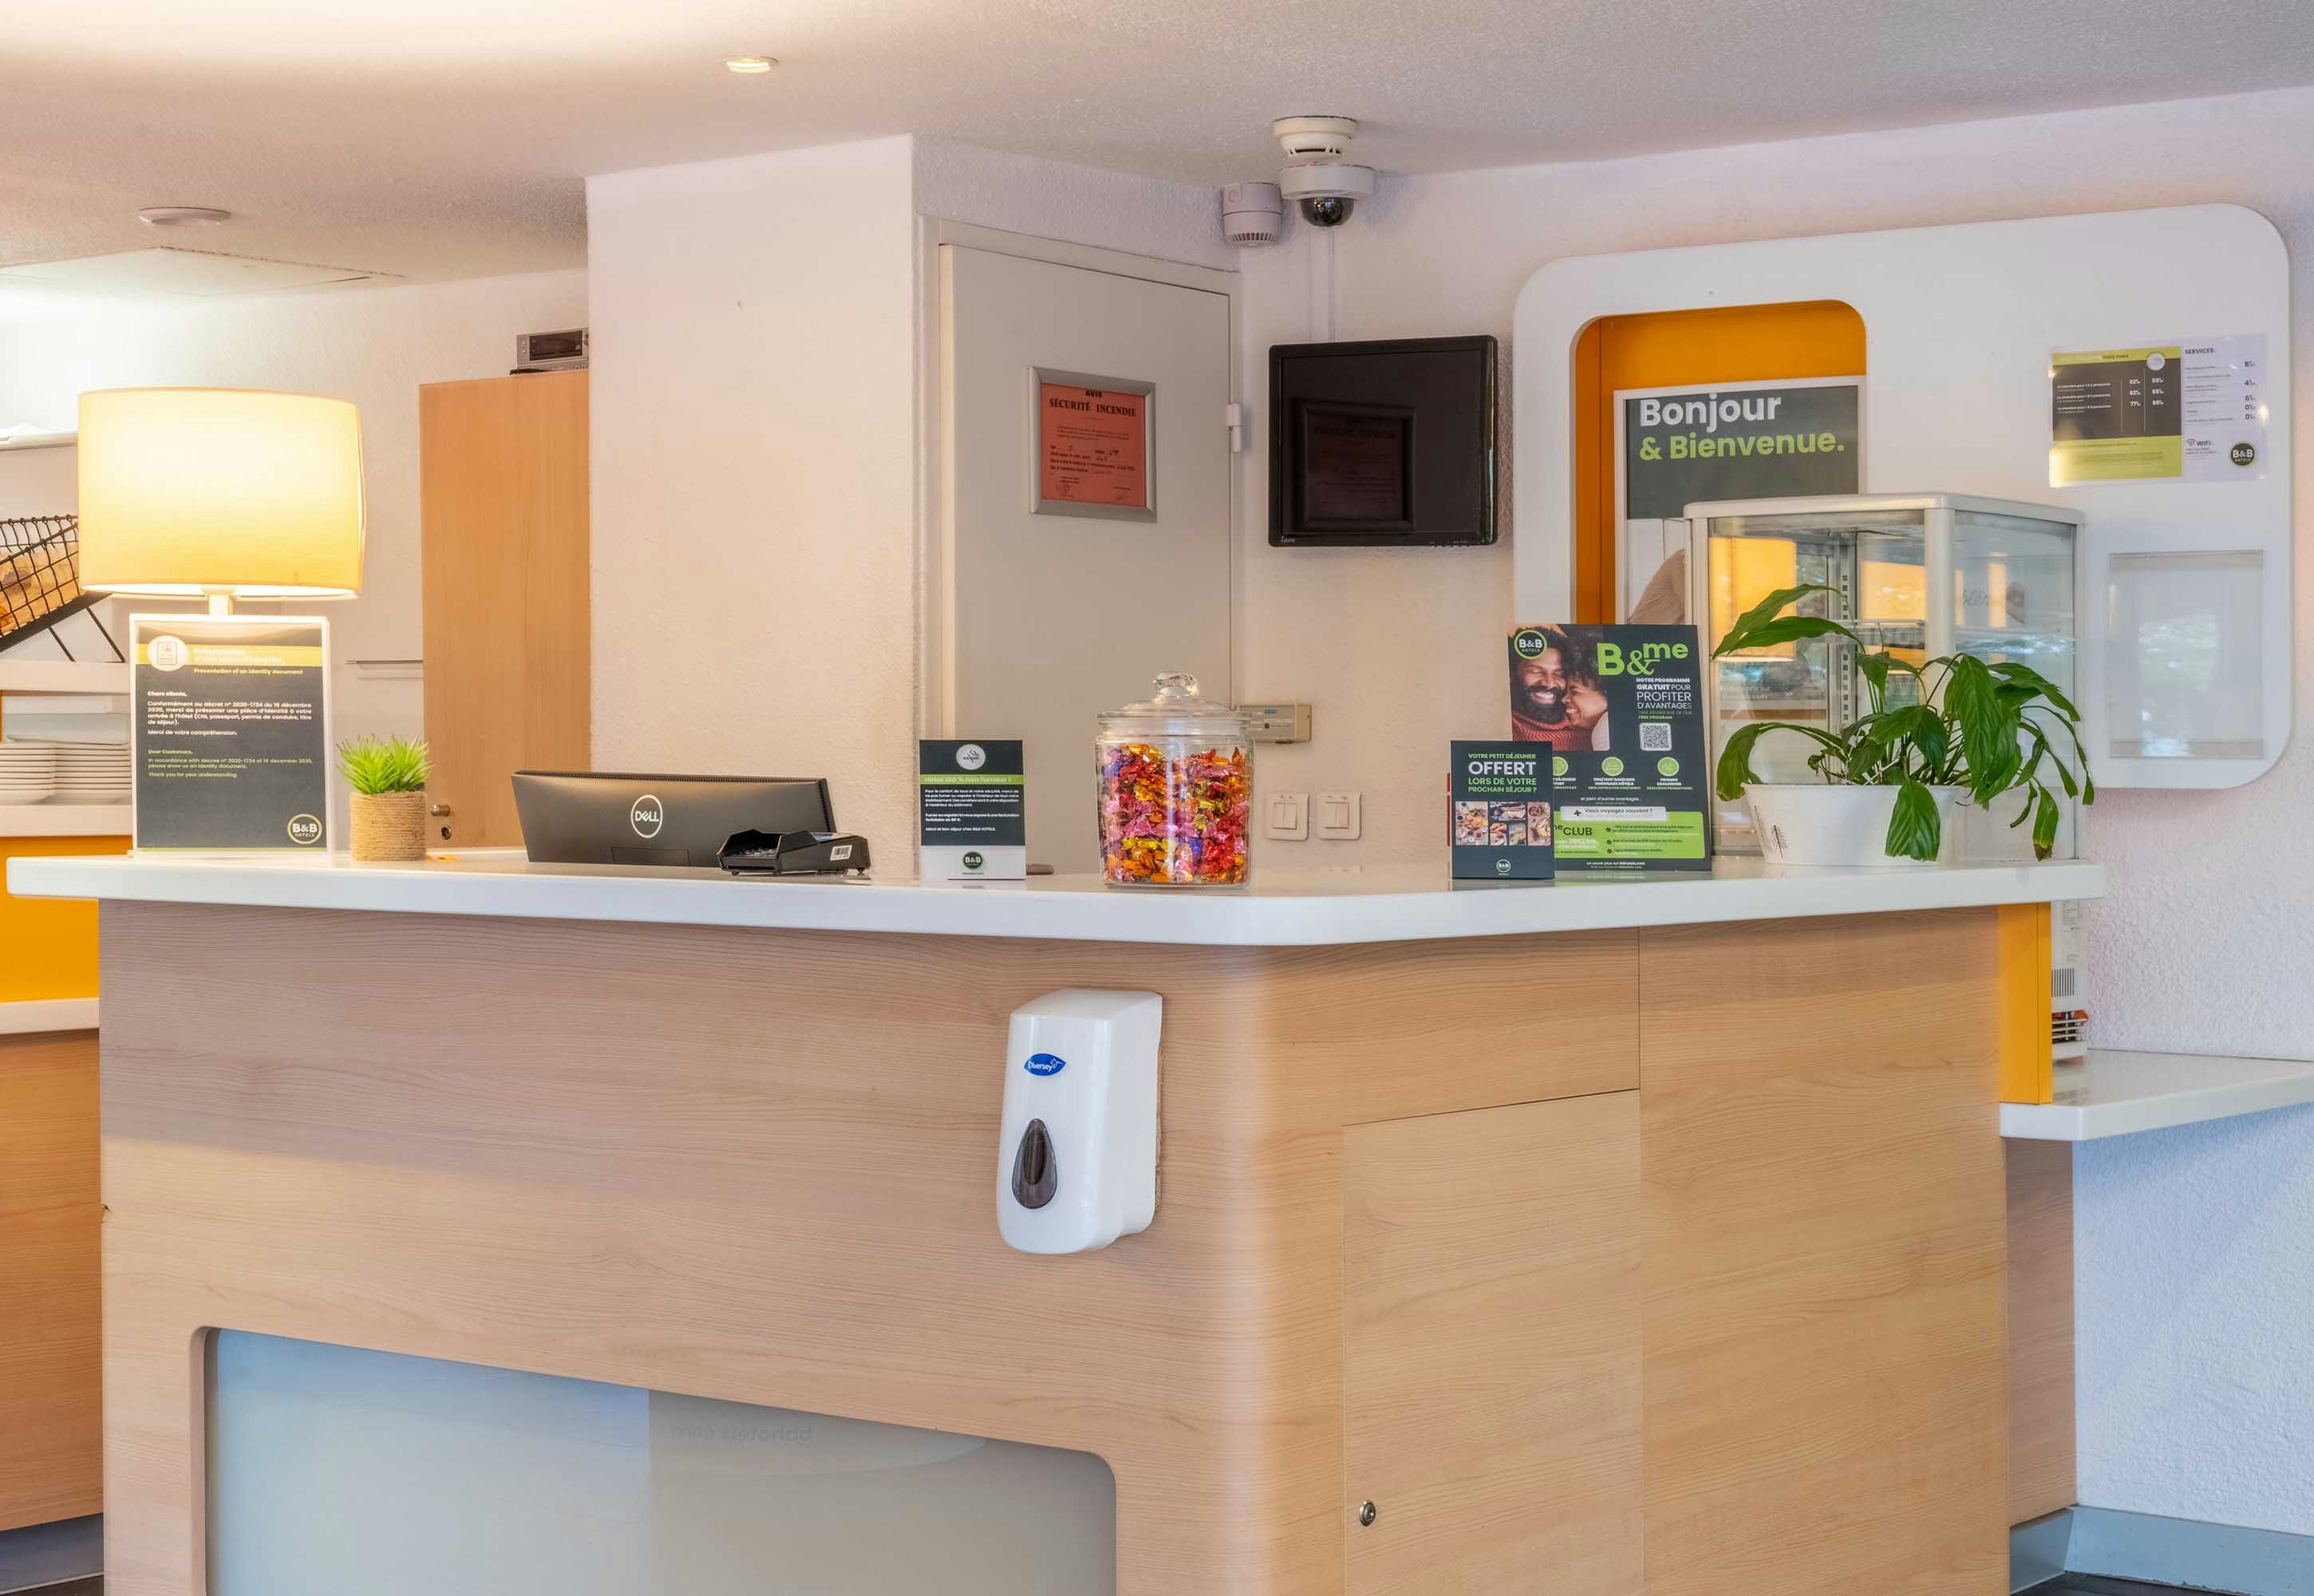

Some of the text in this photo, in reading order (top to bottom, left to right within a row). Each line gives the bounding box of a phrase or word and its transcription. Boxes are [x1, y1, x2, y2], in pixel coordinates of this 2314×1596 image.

[1085, 389, 1103, 398] AVIS
[1049, 397, 1136, 417] SÉCURITÉ INCENDIE
[1640, 393, 1782, 433] Bonjour
[1639, 431, 1845, 460] & Bienvenue.
[2233, 449, 2253, 458] B&B
[1518, 638, 1543, 648] B&B
[1597, 643, 1688, 676] B&me
[1637, 691, 1692, 701] PROFITER
[1468, 761, 1537, 776] OFFERT
[635, 811, 659, 822] DELL
[292, 823, 318, 833] B&B
[1563, 827, 1593, 836] CLUB
[1029, 1061, 1052, 1072] Diversey
